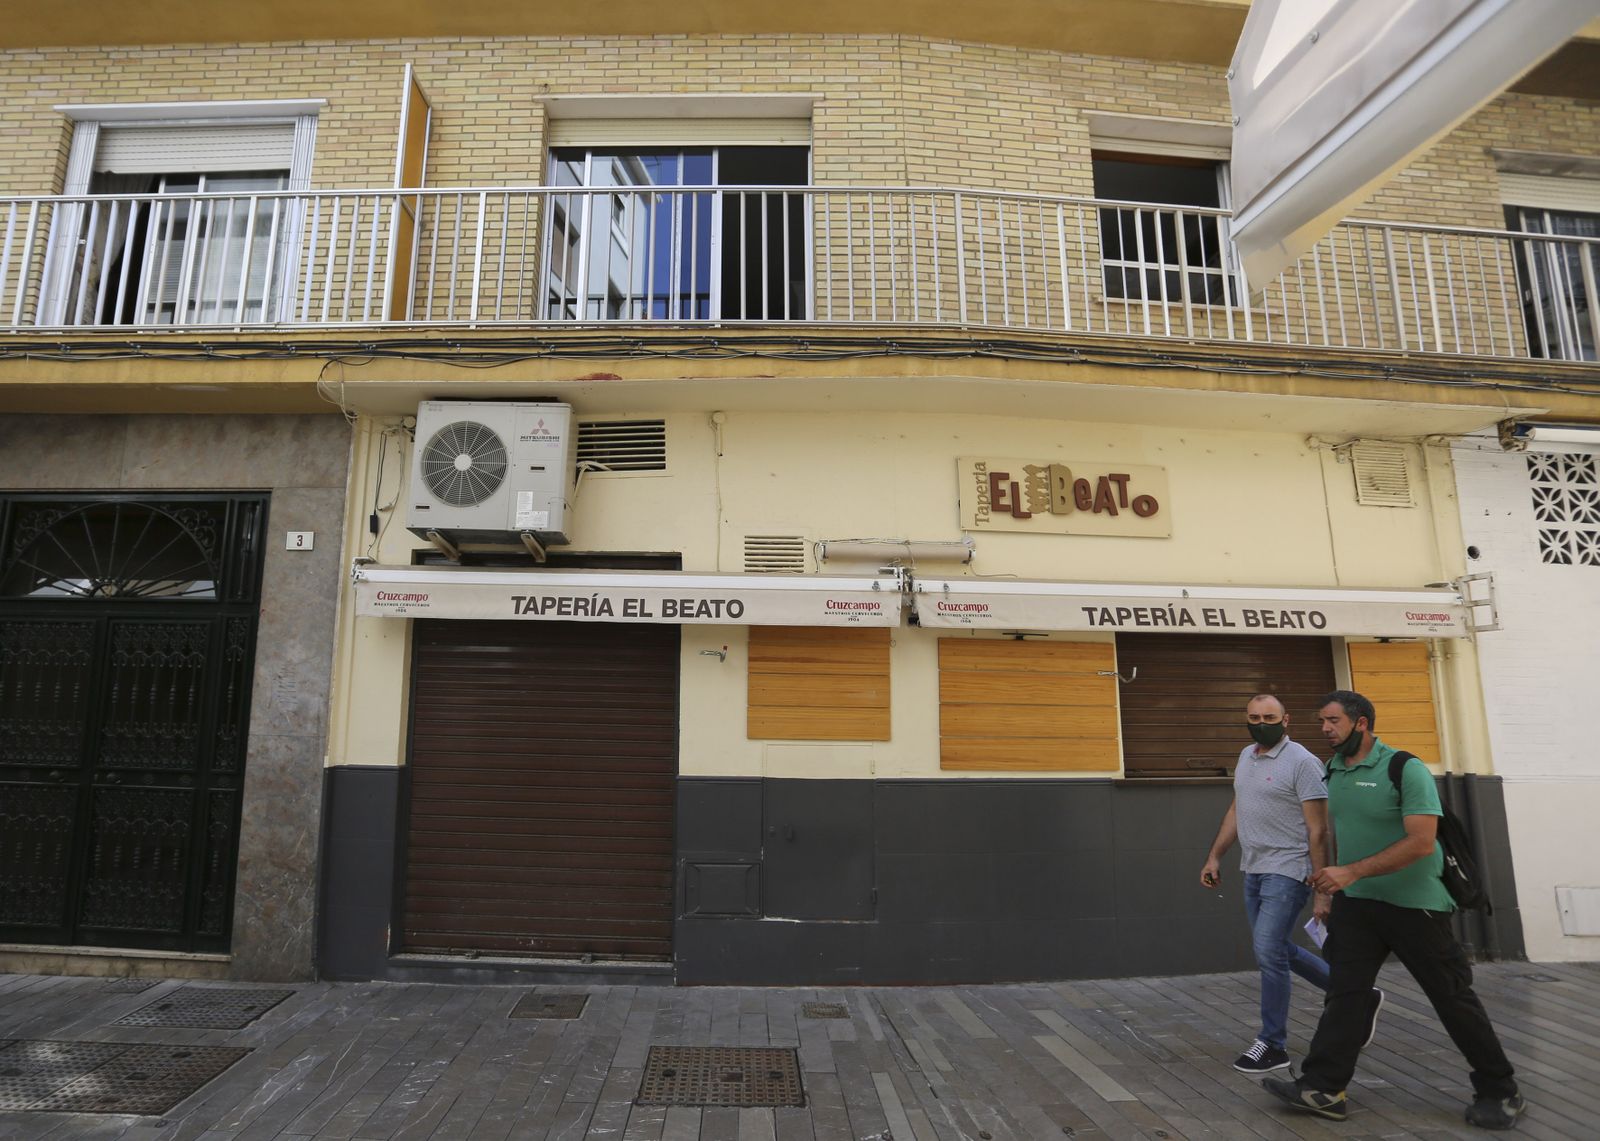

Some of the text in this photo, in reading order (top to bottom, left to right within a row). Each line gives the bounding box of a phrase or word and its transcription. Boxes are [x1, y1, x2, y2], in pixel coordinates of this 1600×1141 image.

[989, 471, 1032, 518] EL
[296, 534, 304, 547] 3
[377, 591, 429, 602] Cruzcampo
[511, 593, 745, 619] TAPERÍA EL BEATO
[826, 600, 880, 611] Cruzcampo
[937, 601, 989, 613] Cruzcampo
[1081, 603, 1328, 630] TAPERÍA EL BEATO
[1405, 611, 1451, 623] Cruzcampo
